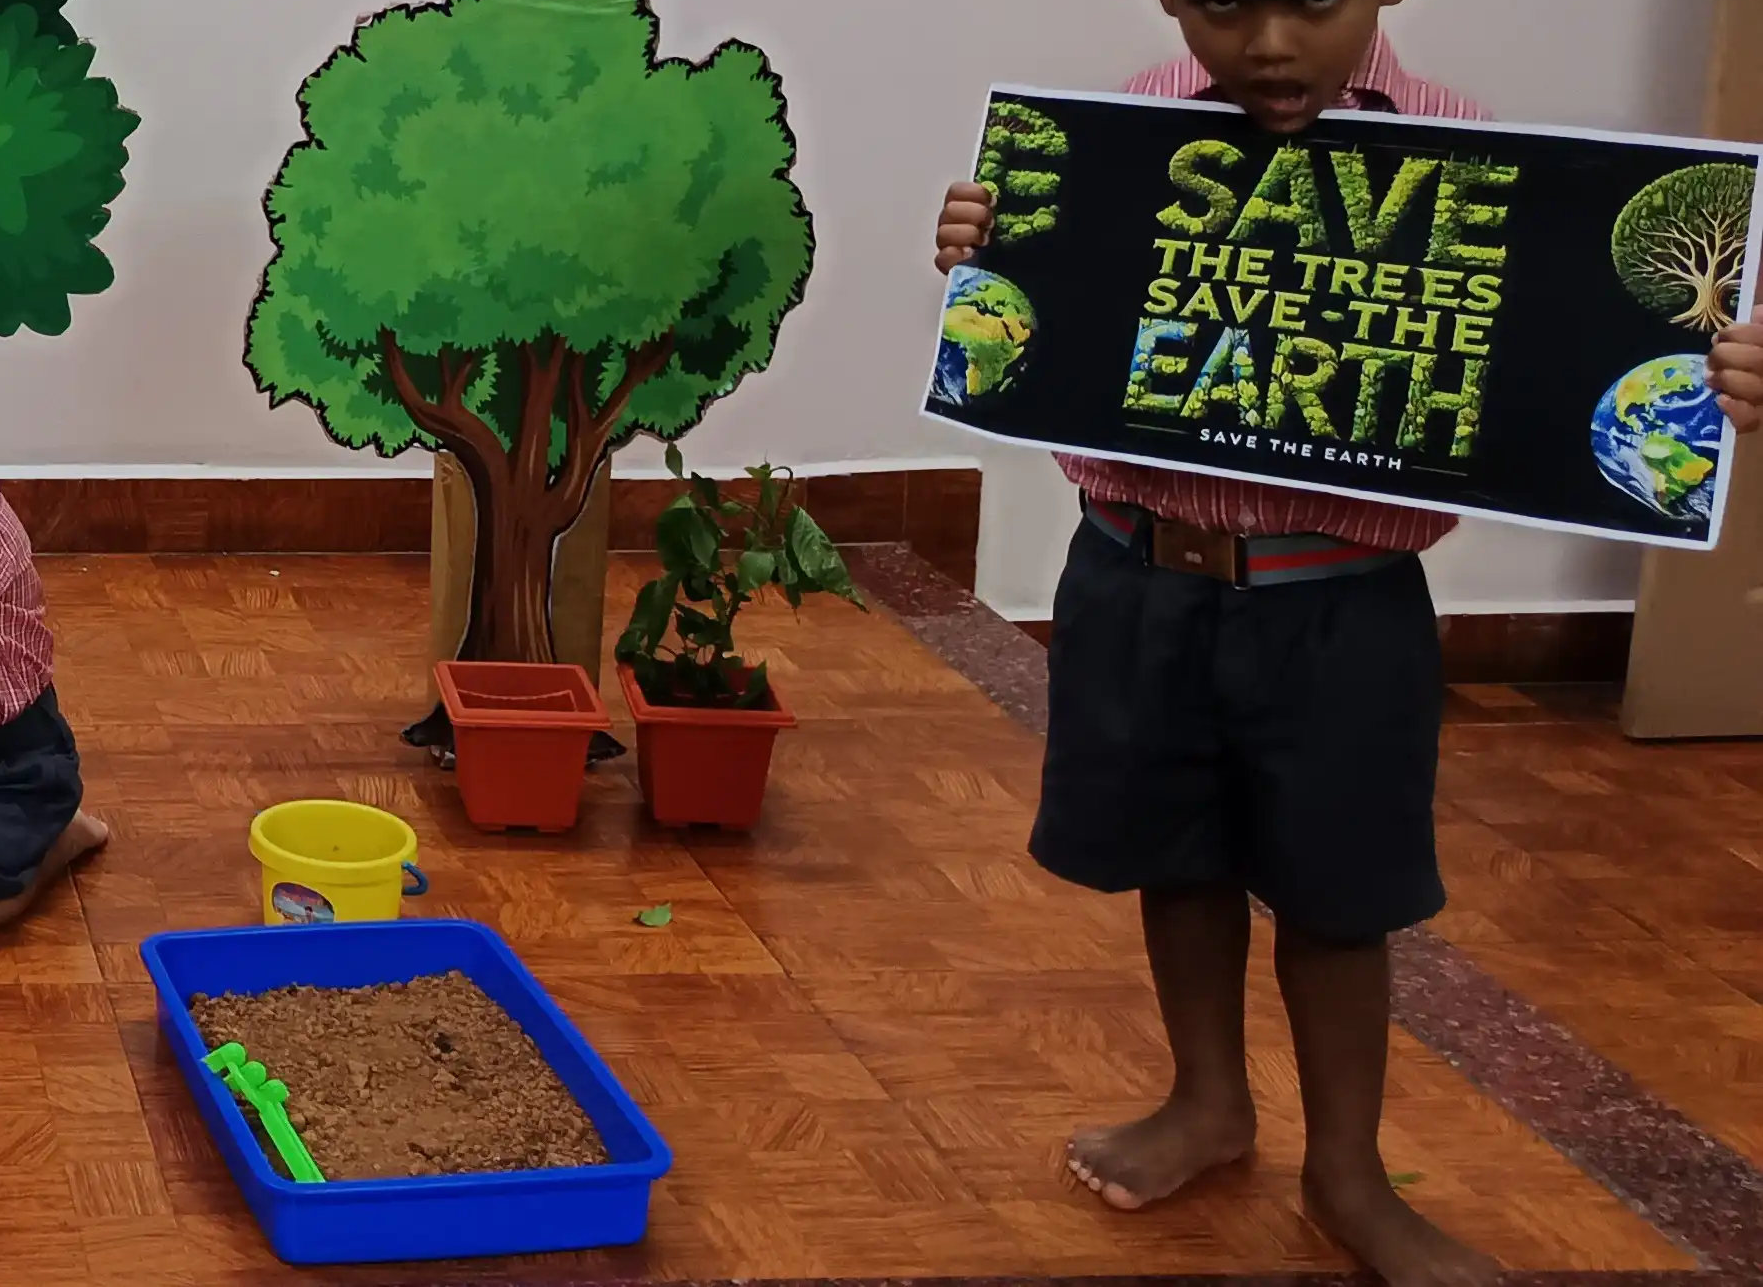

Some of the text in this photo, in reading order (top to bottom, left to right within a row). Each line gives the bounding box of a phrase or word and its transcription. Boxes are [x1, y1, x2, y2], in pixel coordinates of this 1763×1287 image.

[1155, 138, 1521, 268] SAVE
[1151, 238, 1503, 313] THE TREES
[1121, 315, 1491, 459] EARTH
[1199, 427, 1404, 472] SAVE THE EARTH
